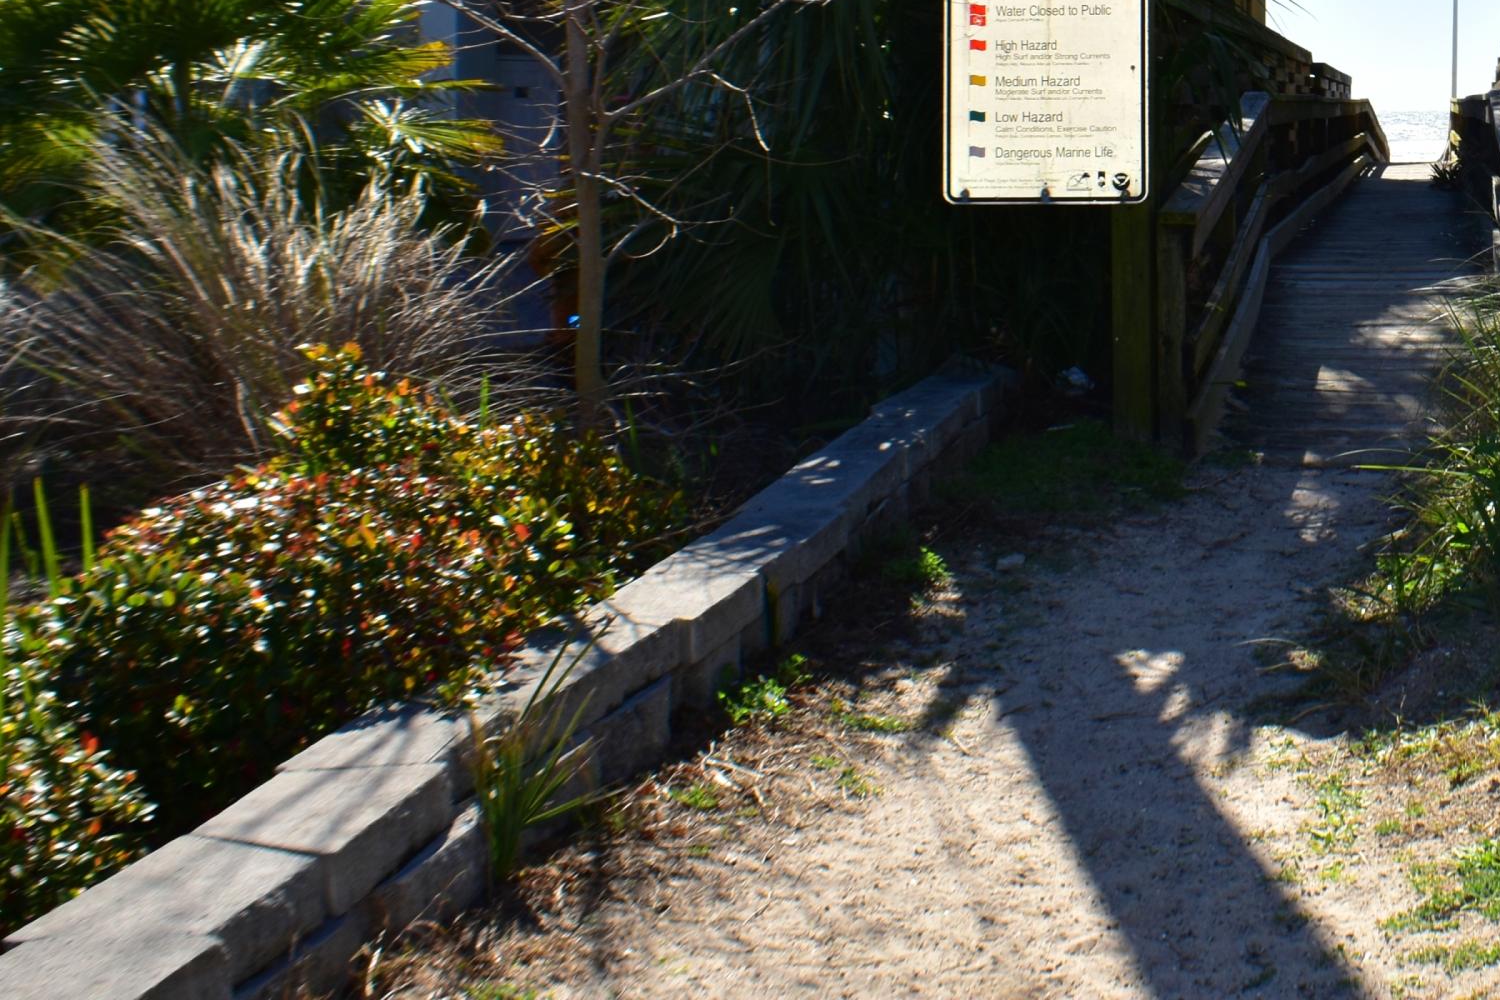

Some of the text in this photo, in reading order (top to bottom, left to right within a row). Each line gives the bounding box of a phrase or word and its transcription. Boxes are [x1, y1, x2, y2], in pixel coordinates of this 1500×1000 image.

[996, 4, 1112, 17] Water Closed to Public
[995, 40, 1057, 54] High Hazard
[1055, 53, 1078, 61] Strong
[995, 75, 1081, 87] Medium Hazard
[995, 111, 1063, 122] Low Hazard
[995, 146, 1113, 160] Dangerous Marine Life
